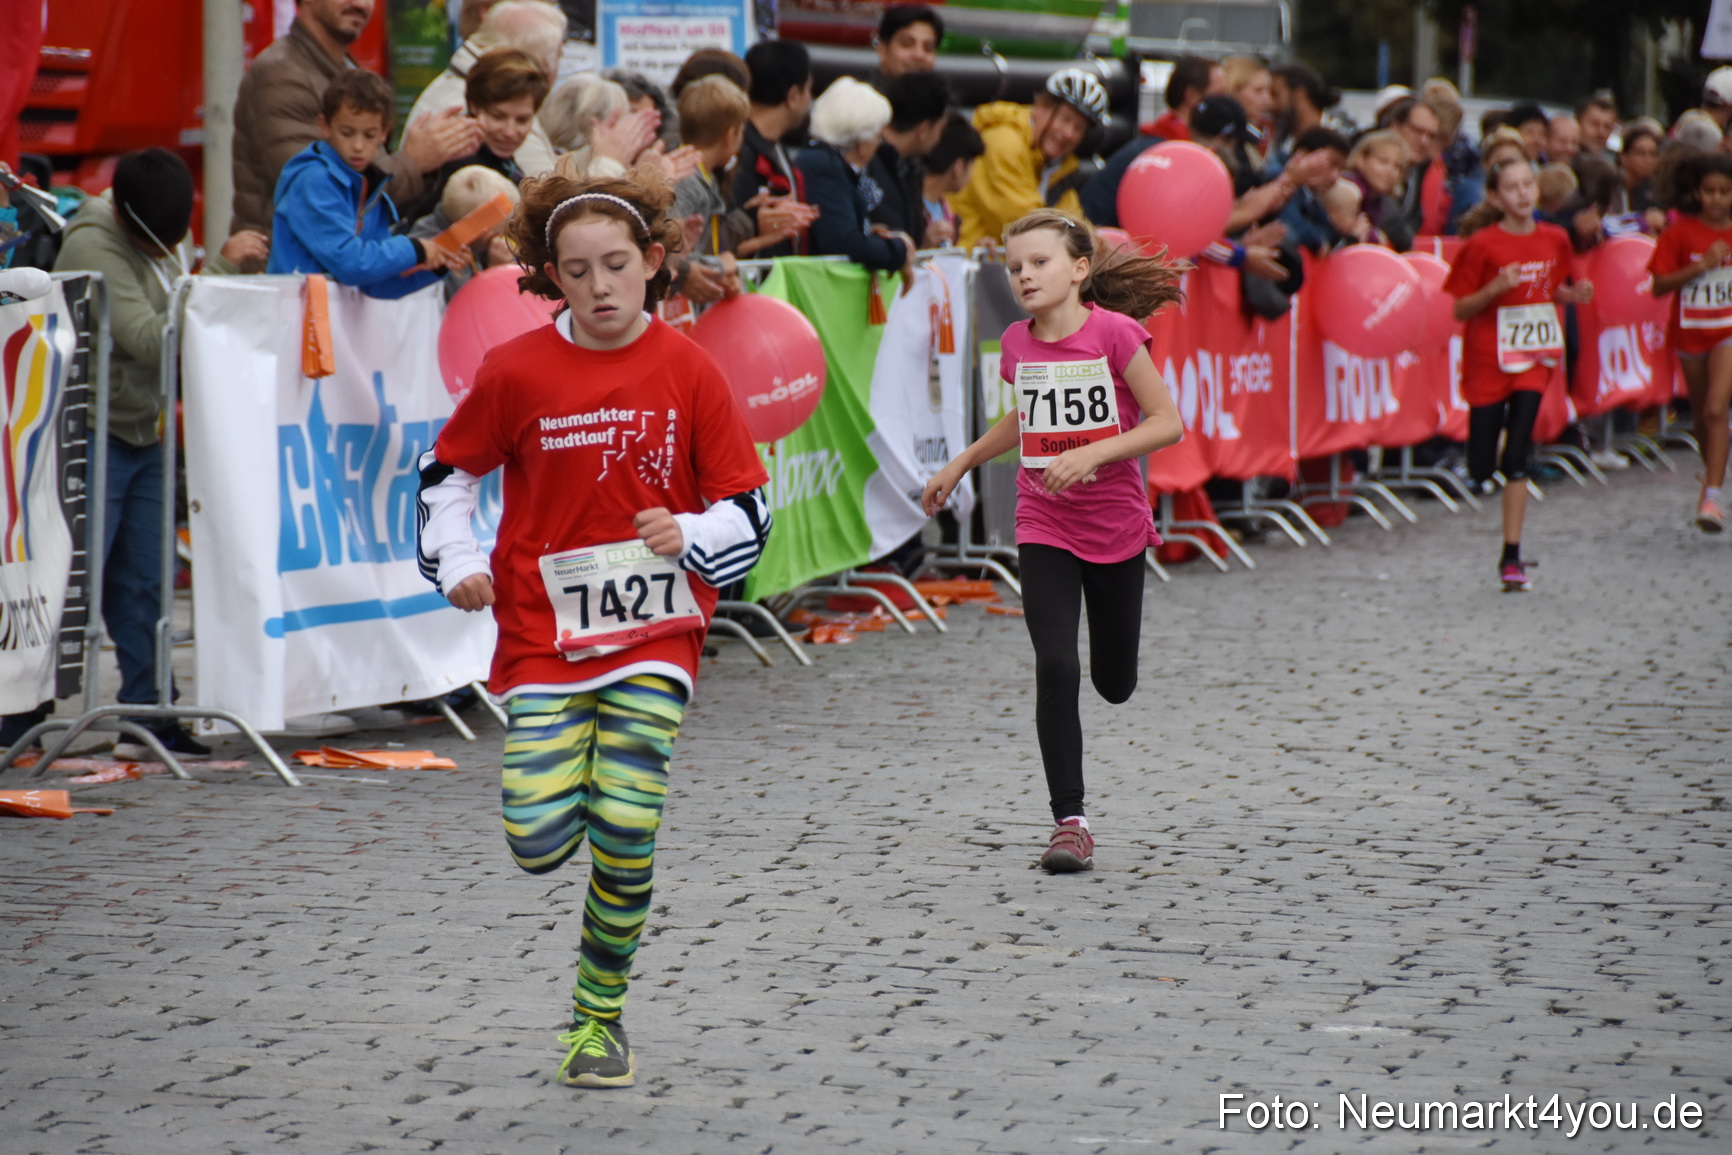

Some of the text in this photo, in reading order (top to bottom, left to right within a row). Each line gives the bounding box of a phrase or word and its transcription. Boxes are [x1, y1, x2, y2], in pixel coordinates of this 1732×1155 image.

[1055, 363, 1105, 379] BOCK
[1023, 385, 1110, 427] 7158
[539, 407, 636, 431] Neumarkter
[540, 427, 616, 451] Stadtlauf
[661, 409, 677, 489] BAMBINI
[1040, 436, 1091, 454] Sophia
[554, 562, 600, 577] NeuerMarkt
[563, 572, 675, 630] 7427
